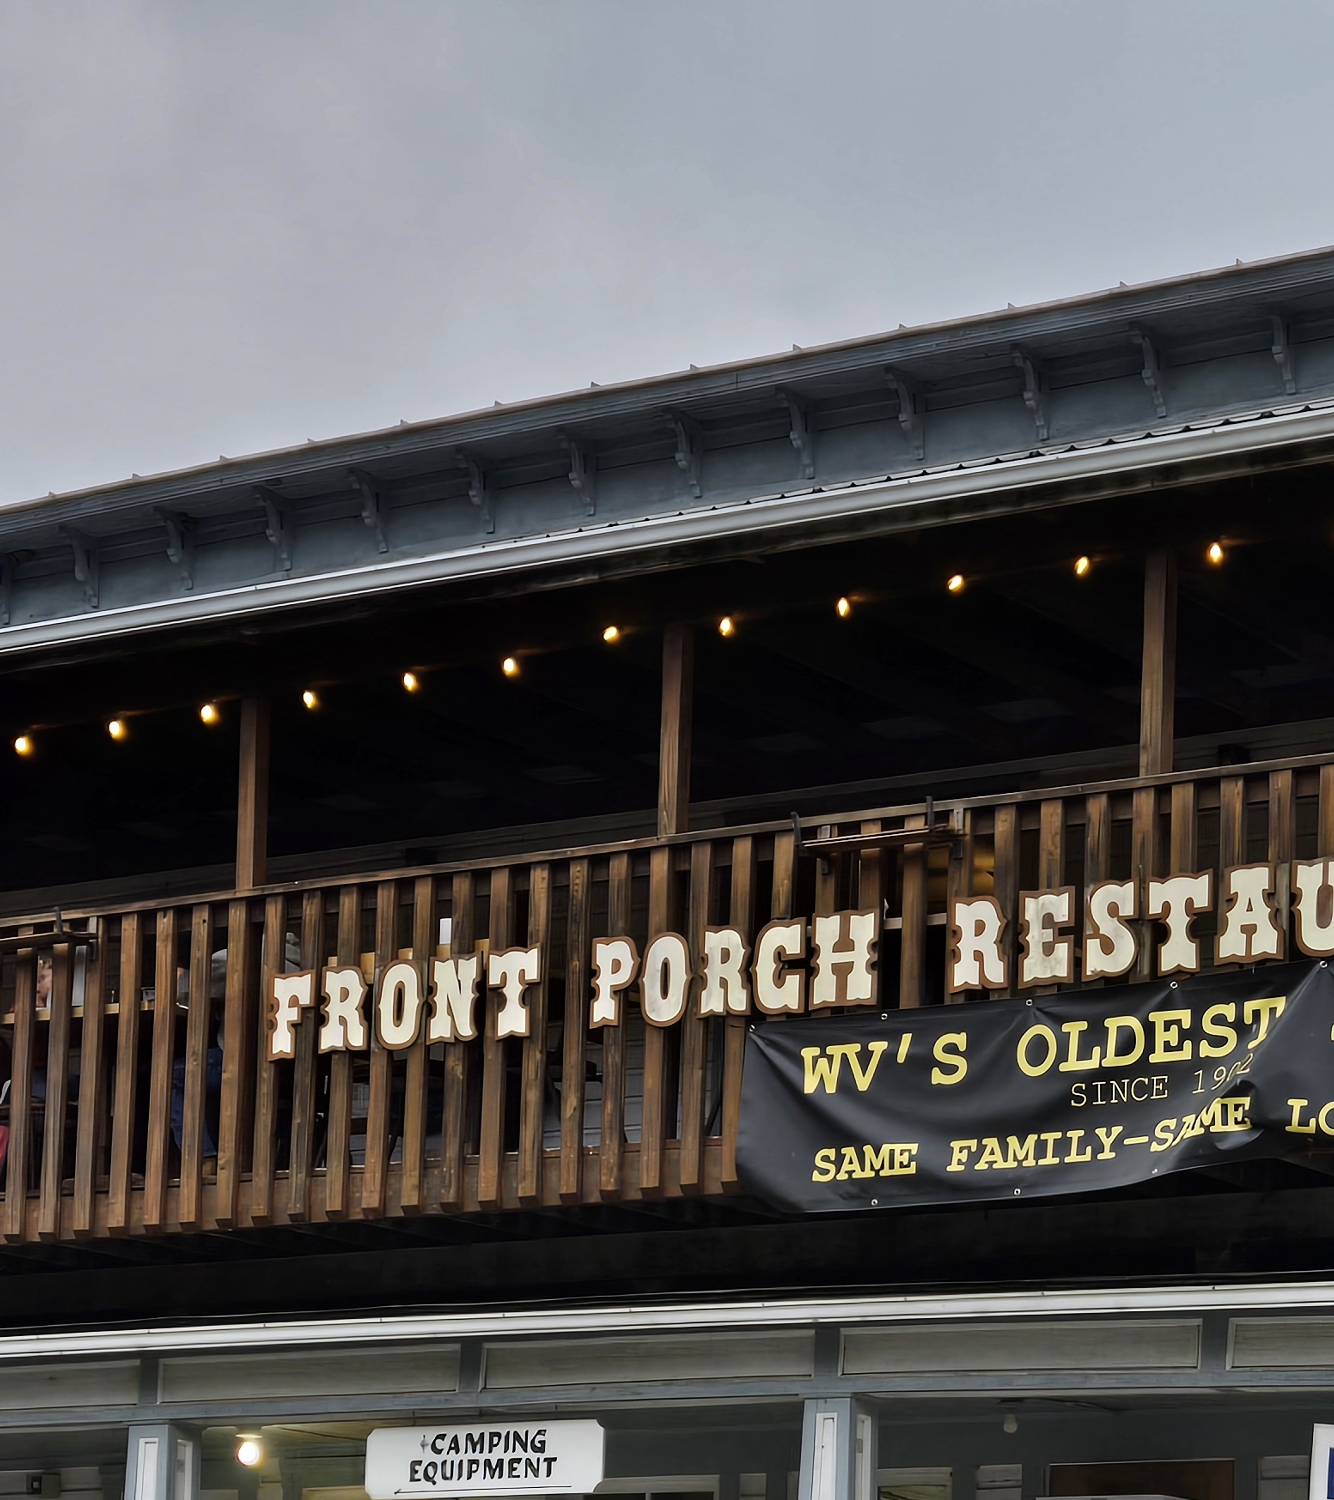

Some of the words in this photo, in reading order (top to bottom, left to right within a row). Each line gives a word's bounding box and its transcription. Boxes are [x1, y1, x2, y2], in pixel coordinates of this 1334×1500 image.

[269, 945, 542, 1061] FRONT
[590, 909, 878, 1028] PORCH
[801, 1033, 968, 1094] WV'S
[1017, 996, 1286, 1077] OLDEST
[1071, 1076, 1168, 1107] SINCE
[812, 1142, 919, 1182] SAME
[429, 1429, 548, 1455] CAMPING
[409, 1457, 558, 1483] EQUIPMENT
